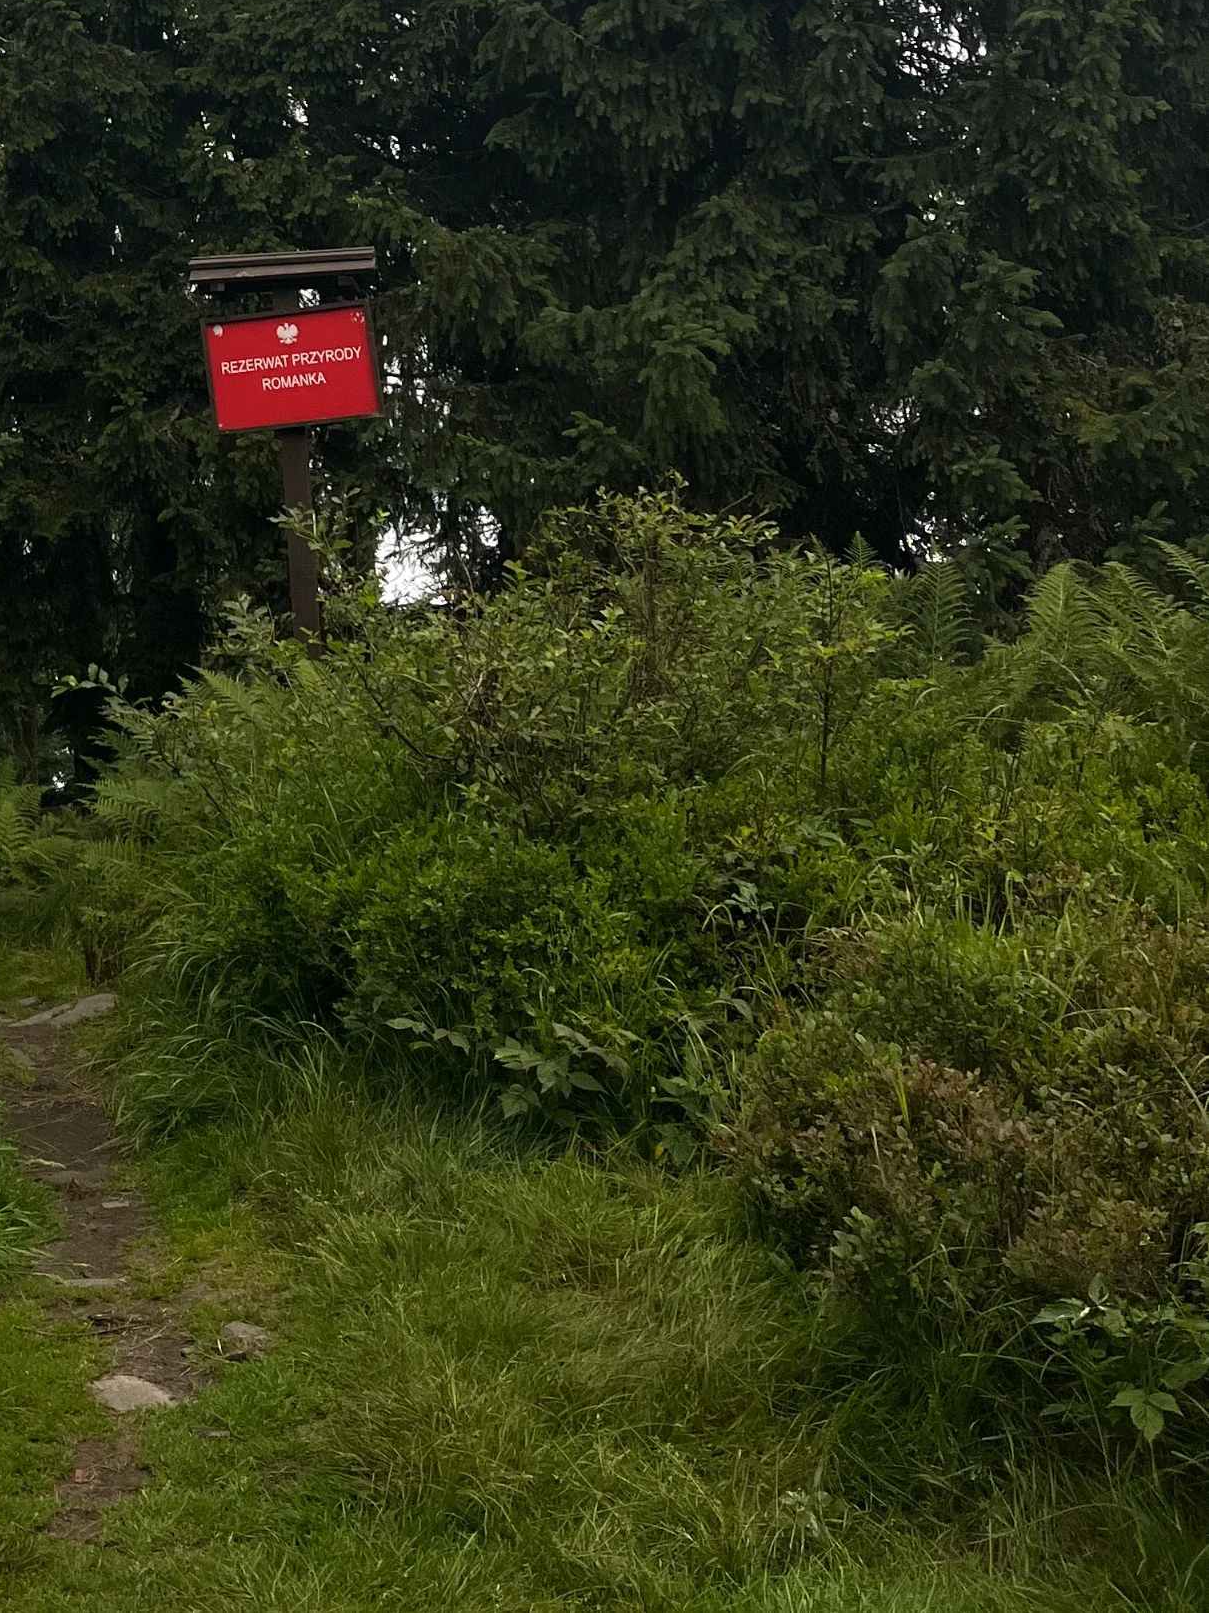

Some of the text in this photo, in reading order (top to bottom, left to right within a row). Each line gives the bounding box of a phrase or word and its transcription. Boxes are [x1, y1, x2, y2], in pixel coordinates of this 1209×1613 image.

[221, 346, 361, 374] REZERWAT PRZYRODY
[262, 372, 326, 390] ROMANKA
